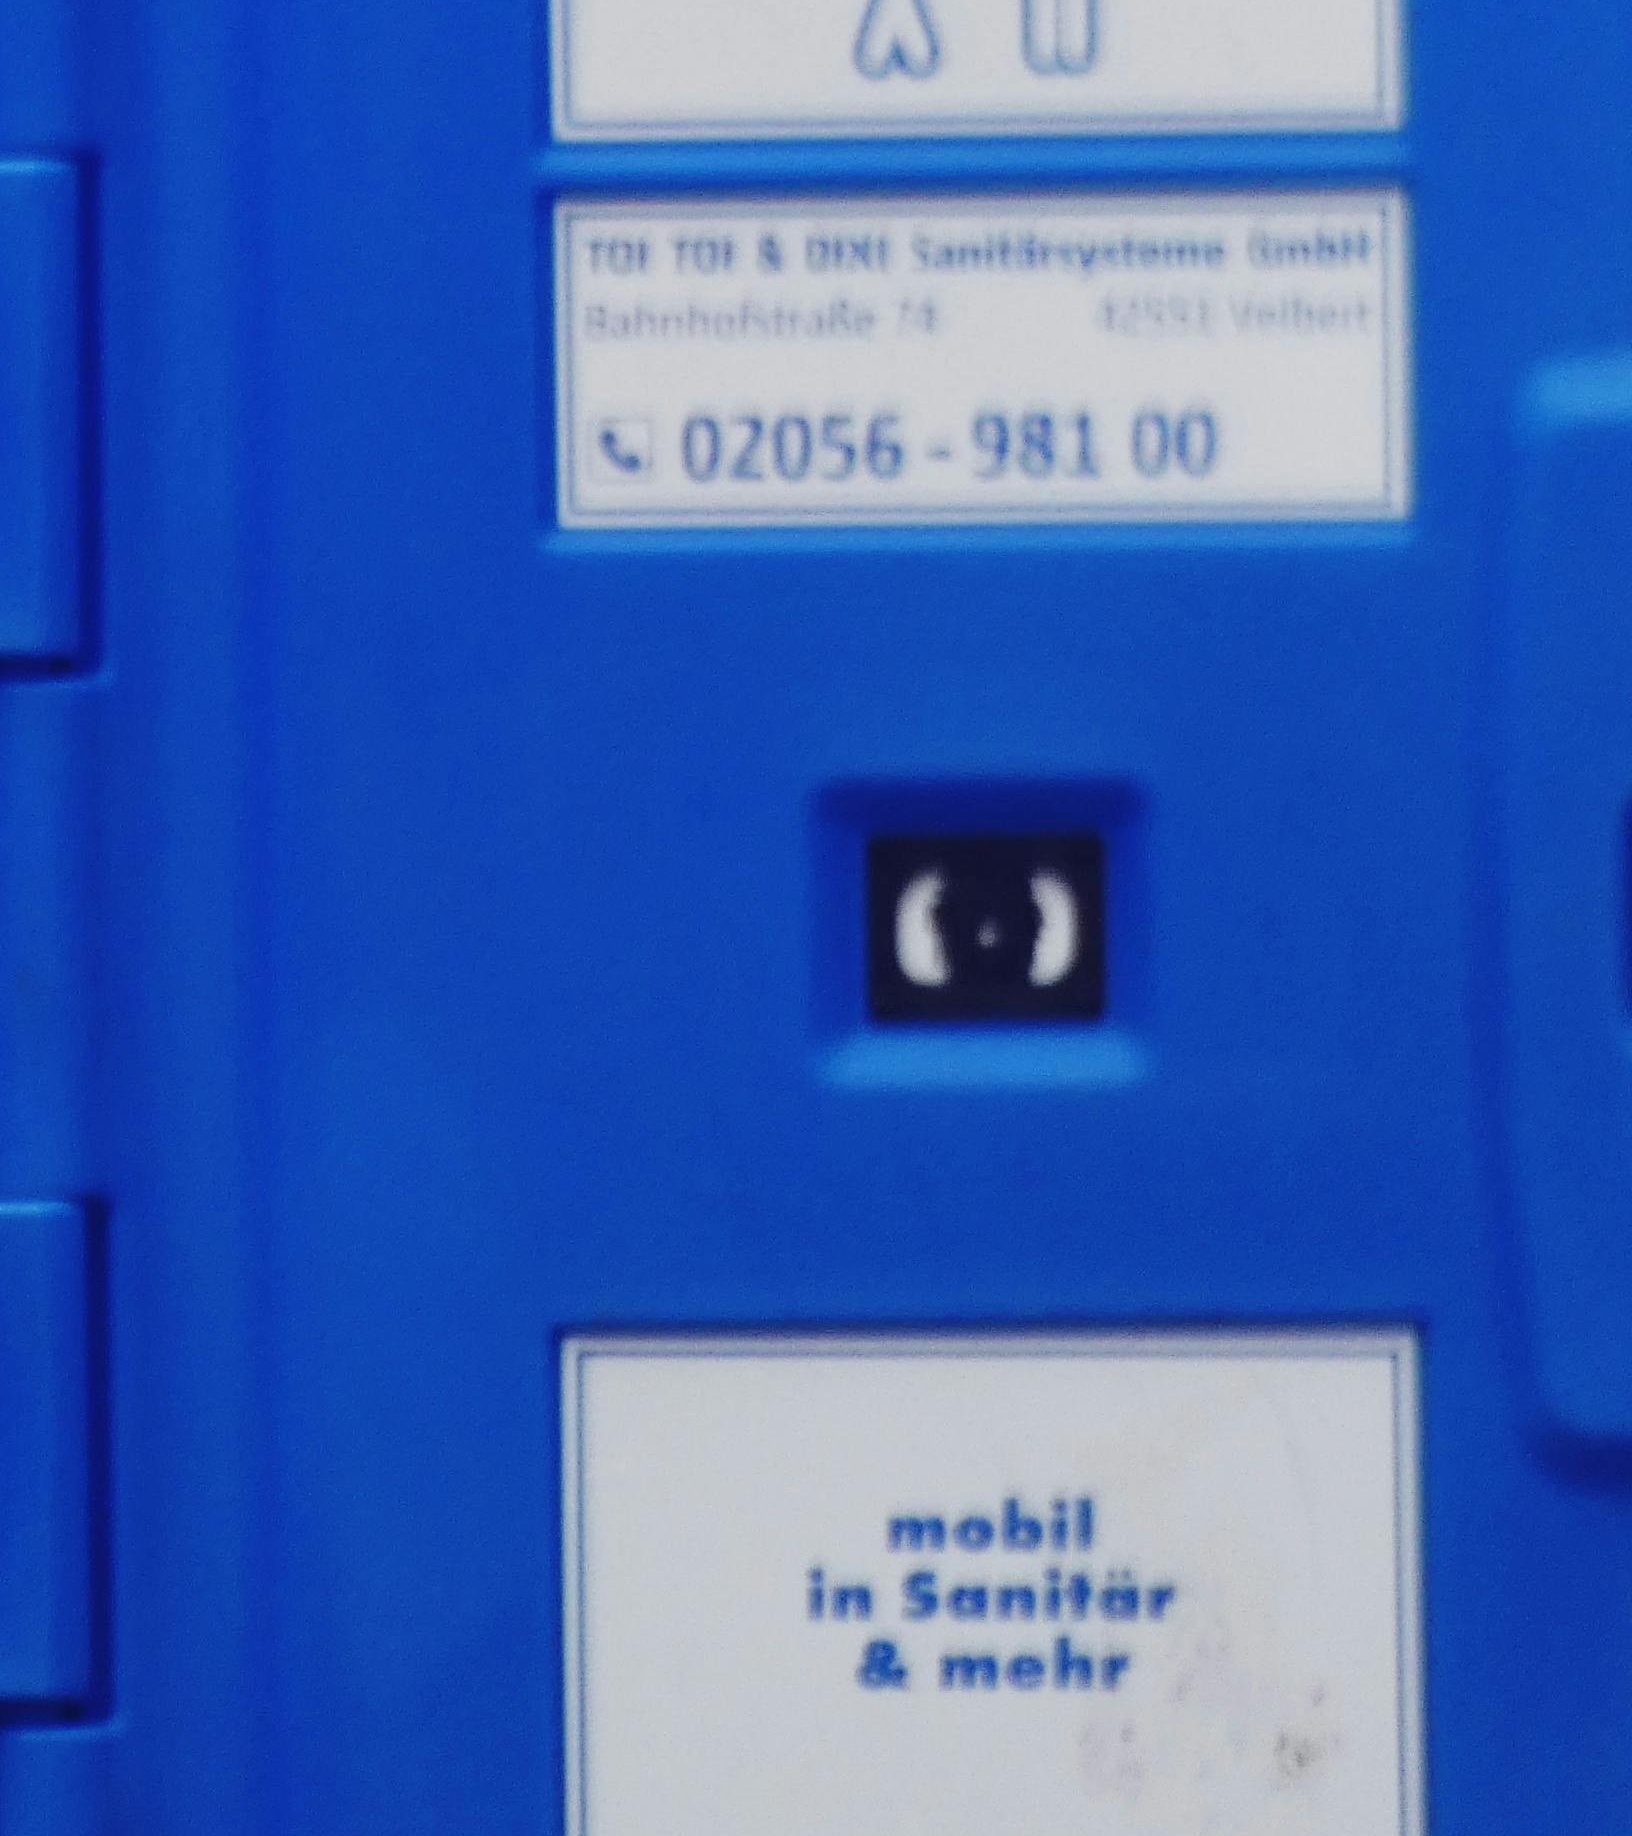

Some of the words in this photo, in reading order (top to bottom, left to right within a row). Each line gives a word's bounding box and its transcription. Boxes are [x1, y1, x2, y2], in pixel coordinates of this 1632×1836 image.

[587, 235, 649, 274] TOI
[671, 234, 738, 274] TOI
[755, 231, 784, 274] &
[806, 232, 890, 273] DIXI
[680, 412, 906, 482] 02056
[971, 409, 1102, 481] 981
[1132, 407, 1220, 478] 00
[886, 1496, 1096, 1553] mobil
[807, 1566, 873, 1623] in
[900, 1566, 1179, 1624] Sanitär
[857, 1639, 909, 1692] &
[939, 1635, 1132, 1691] mehr
